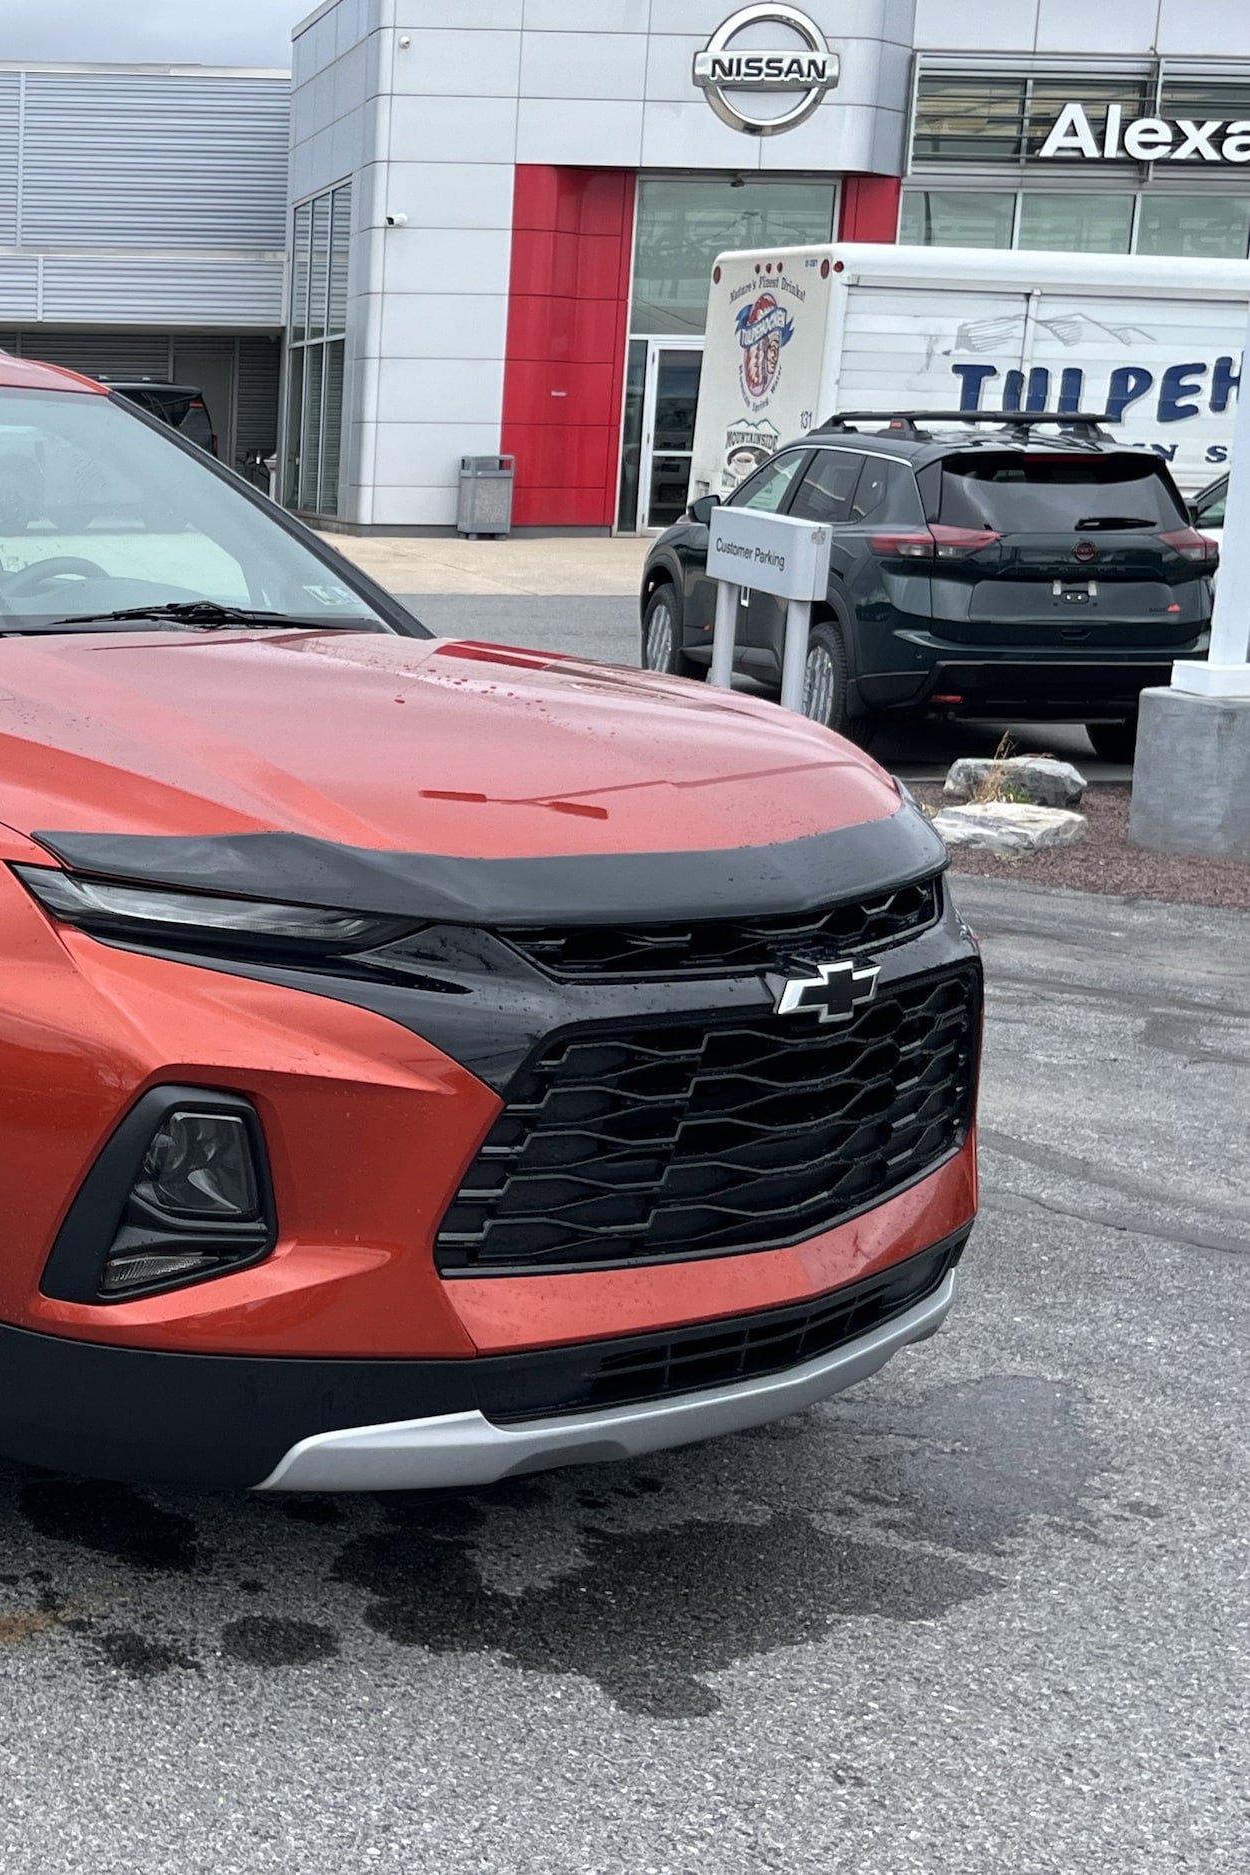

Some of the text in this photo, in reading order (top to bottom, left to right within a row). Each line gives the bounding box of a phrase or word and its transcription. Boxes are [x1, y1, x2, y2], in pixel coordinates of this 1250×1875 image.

[710, 57, 828, 80] NISSAN
[1038, 102, 1250, 163] Alexa
[758, 276, 779, 289] Finest
[800, 410, 813, 430] 131
[716, 537, 785, 572] Customer Parking
